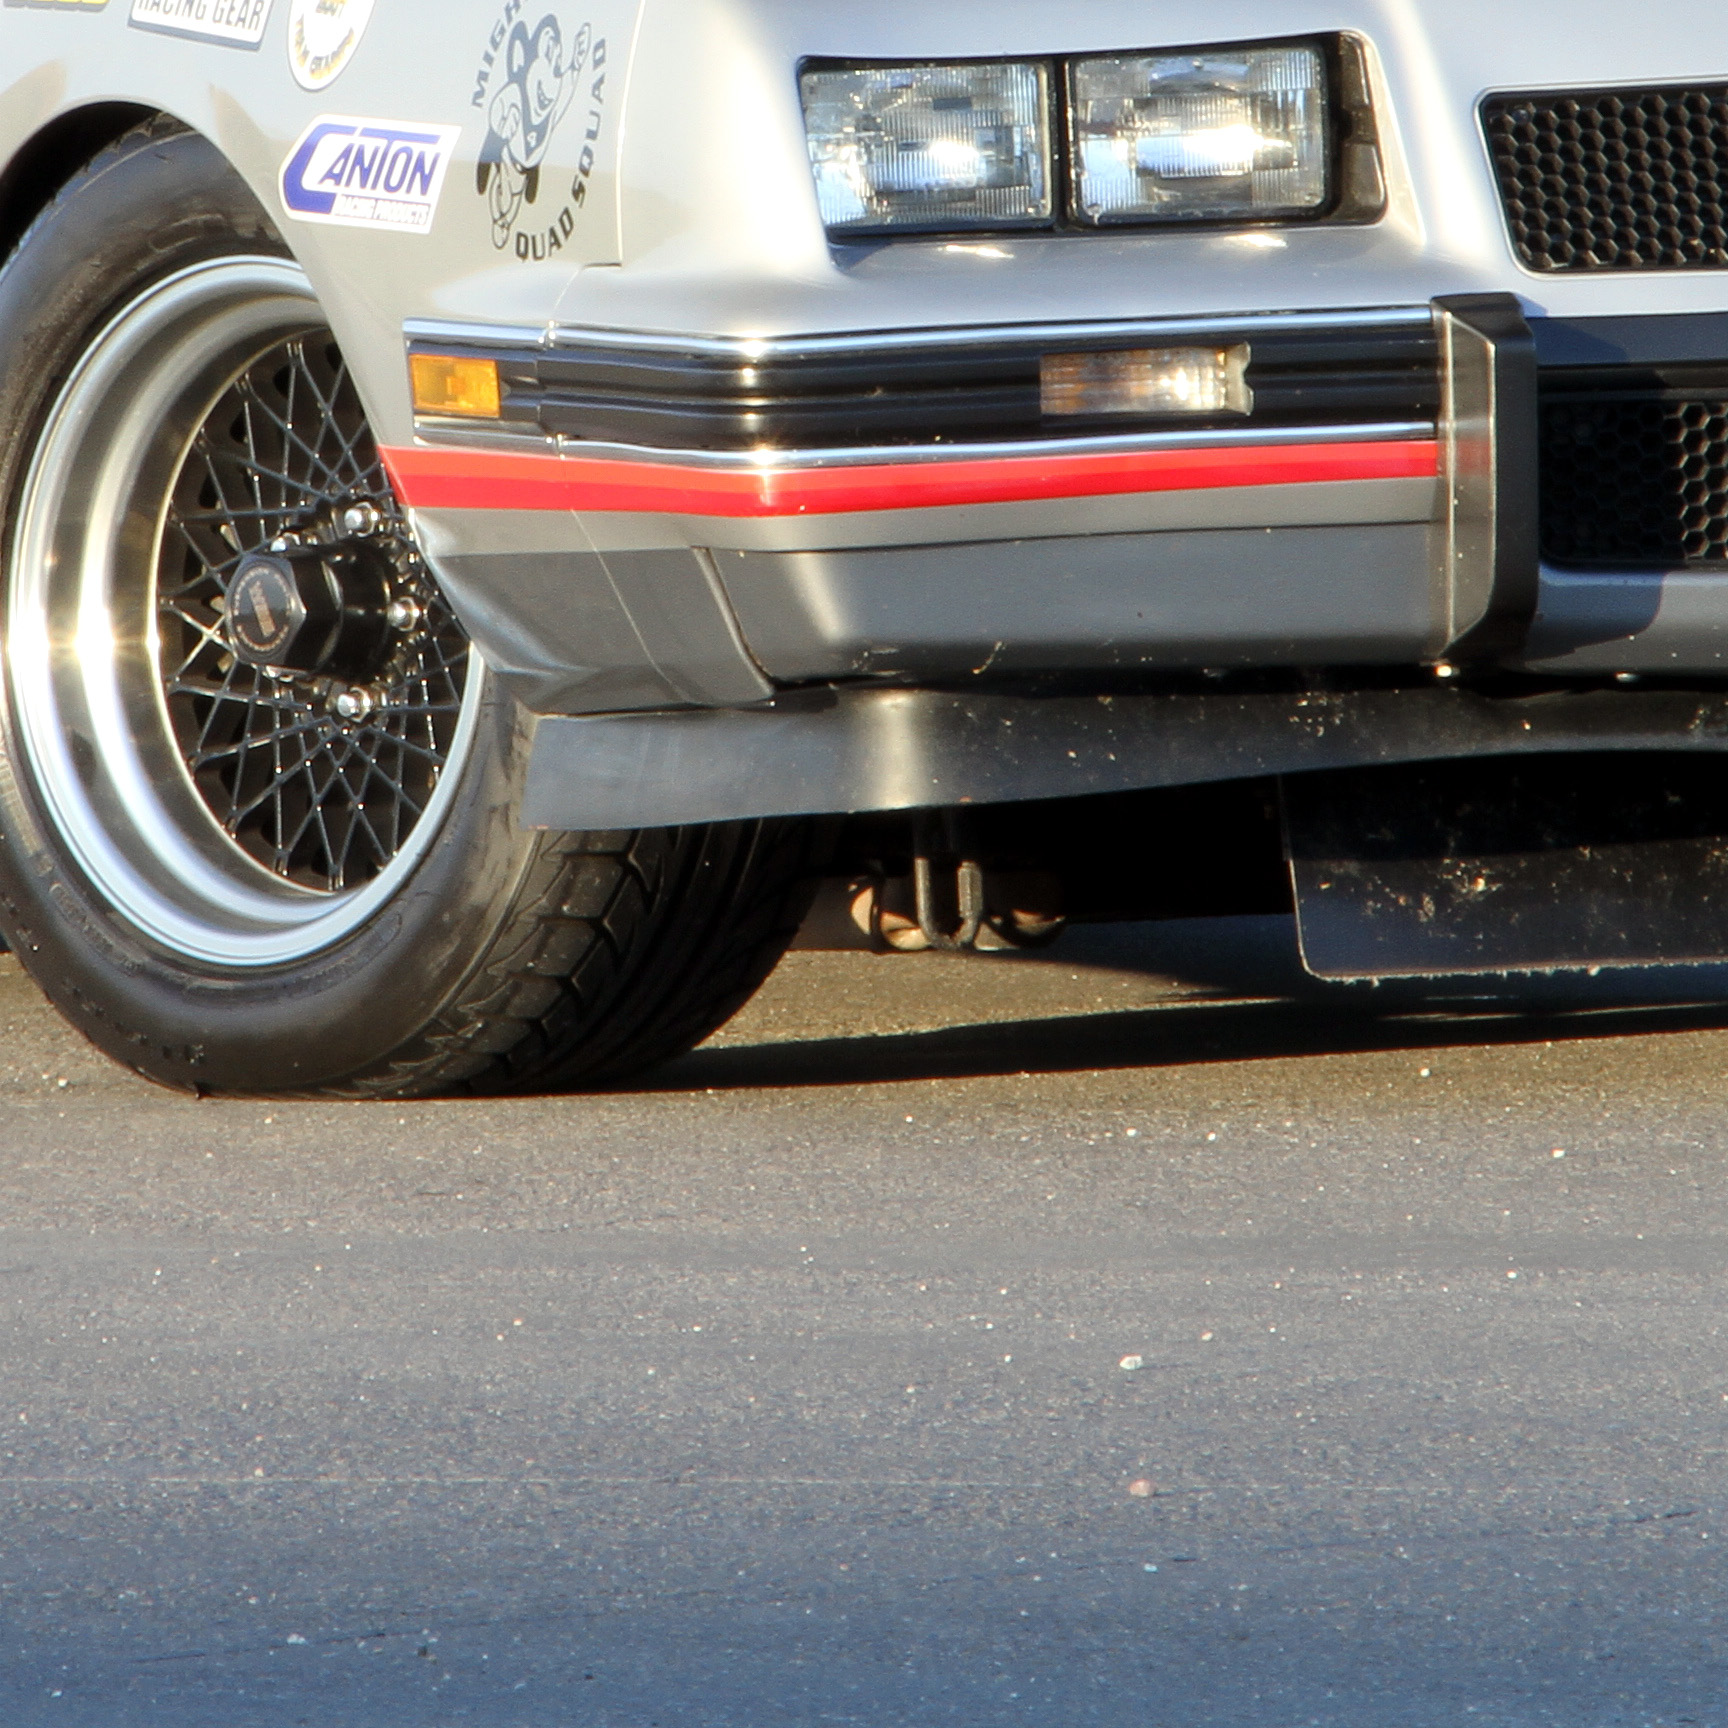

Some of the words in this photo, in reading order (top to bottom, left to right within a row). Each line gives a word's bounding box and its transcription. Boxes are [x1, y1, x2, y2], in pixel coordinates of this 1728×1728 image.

[282, 122, 442, 216] CANTON
[514, 206, 576, 264] QUAD
[571, 37, 607, 209] SQUAD
[374, 199, 430, 226] PRODUCTS
